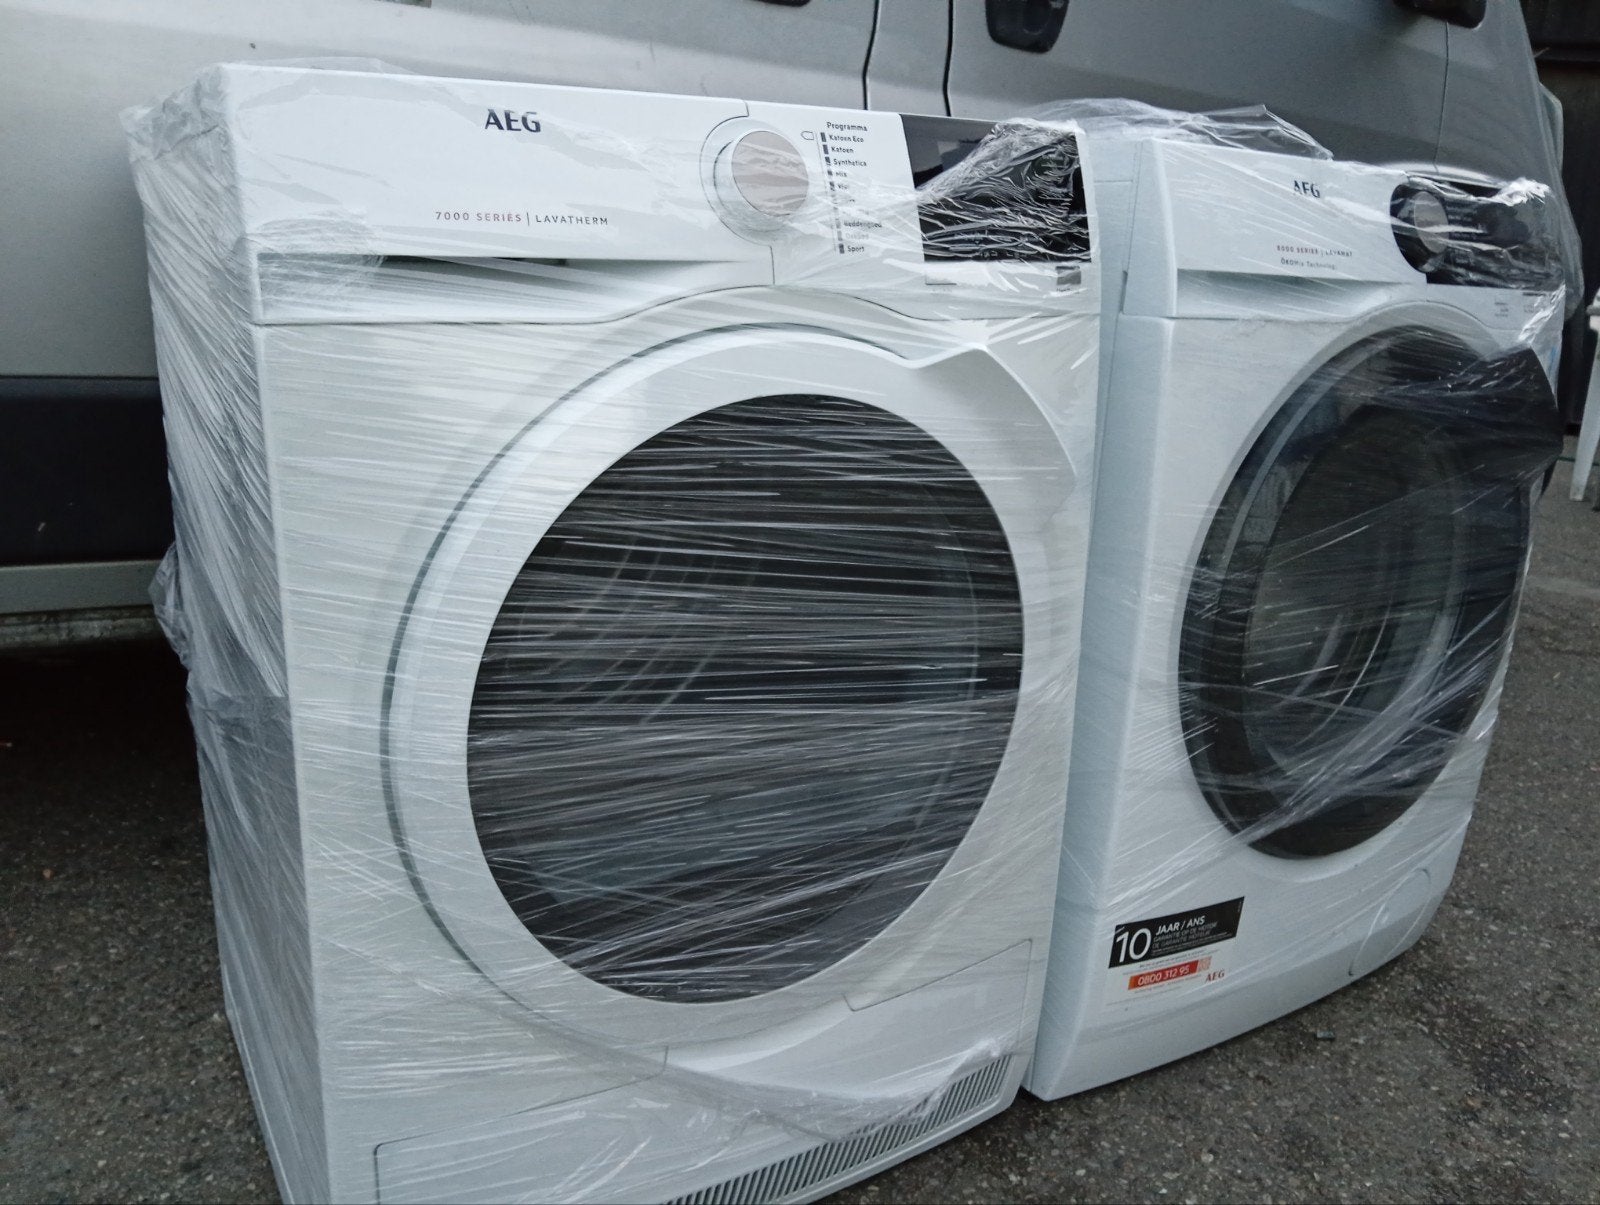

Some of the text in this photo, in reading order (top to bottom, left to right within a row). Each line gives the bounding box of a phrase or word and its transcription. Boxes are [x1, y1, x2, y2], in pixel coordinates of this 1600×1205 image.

[484, 108, 541, 133] AEG
[826, 121, 868, 132] Programma
[829, 134, 864, 143] Katoen Eco
[831, 146, 854, 154] Katoen
[833, 158, 867, 167] Synthetica
[435, 211, 470, 221] 7000
[476, 212, 522, 223] SERIES
[535, 214, 609, 226] LAVATHERM
[847, 245, 865, 253] Sport
[1155, 921, 1180, 936] JAAR
[1186, 915, 1206, 928] ANS
[1116, 927, 1152, 963] 10
[1137, 973, 1162, 986] 0800
[1163, 968, 1178, 980] 312
[1179, 965, 1190, 976] 95
